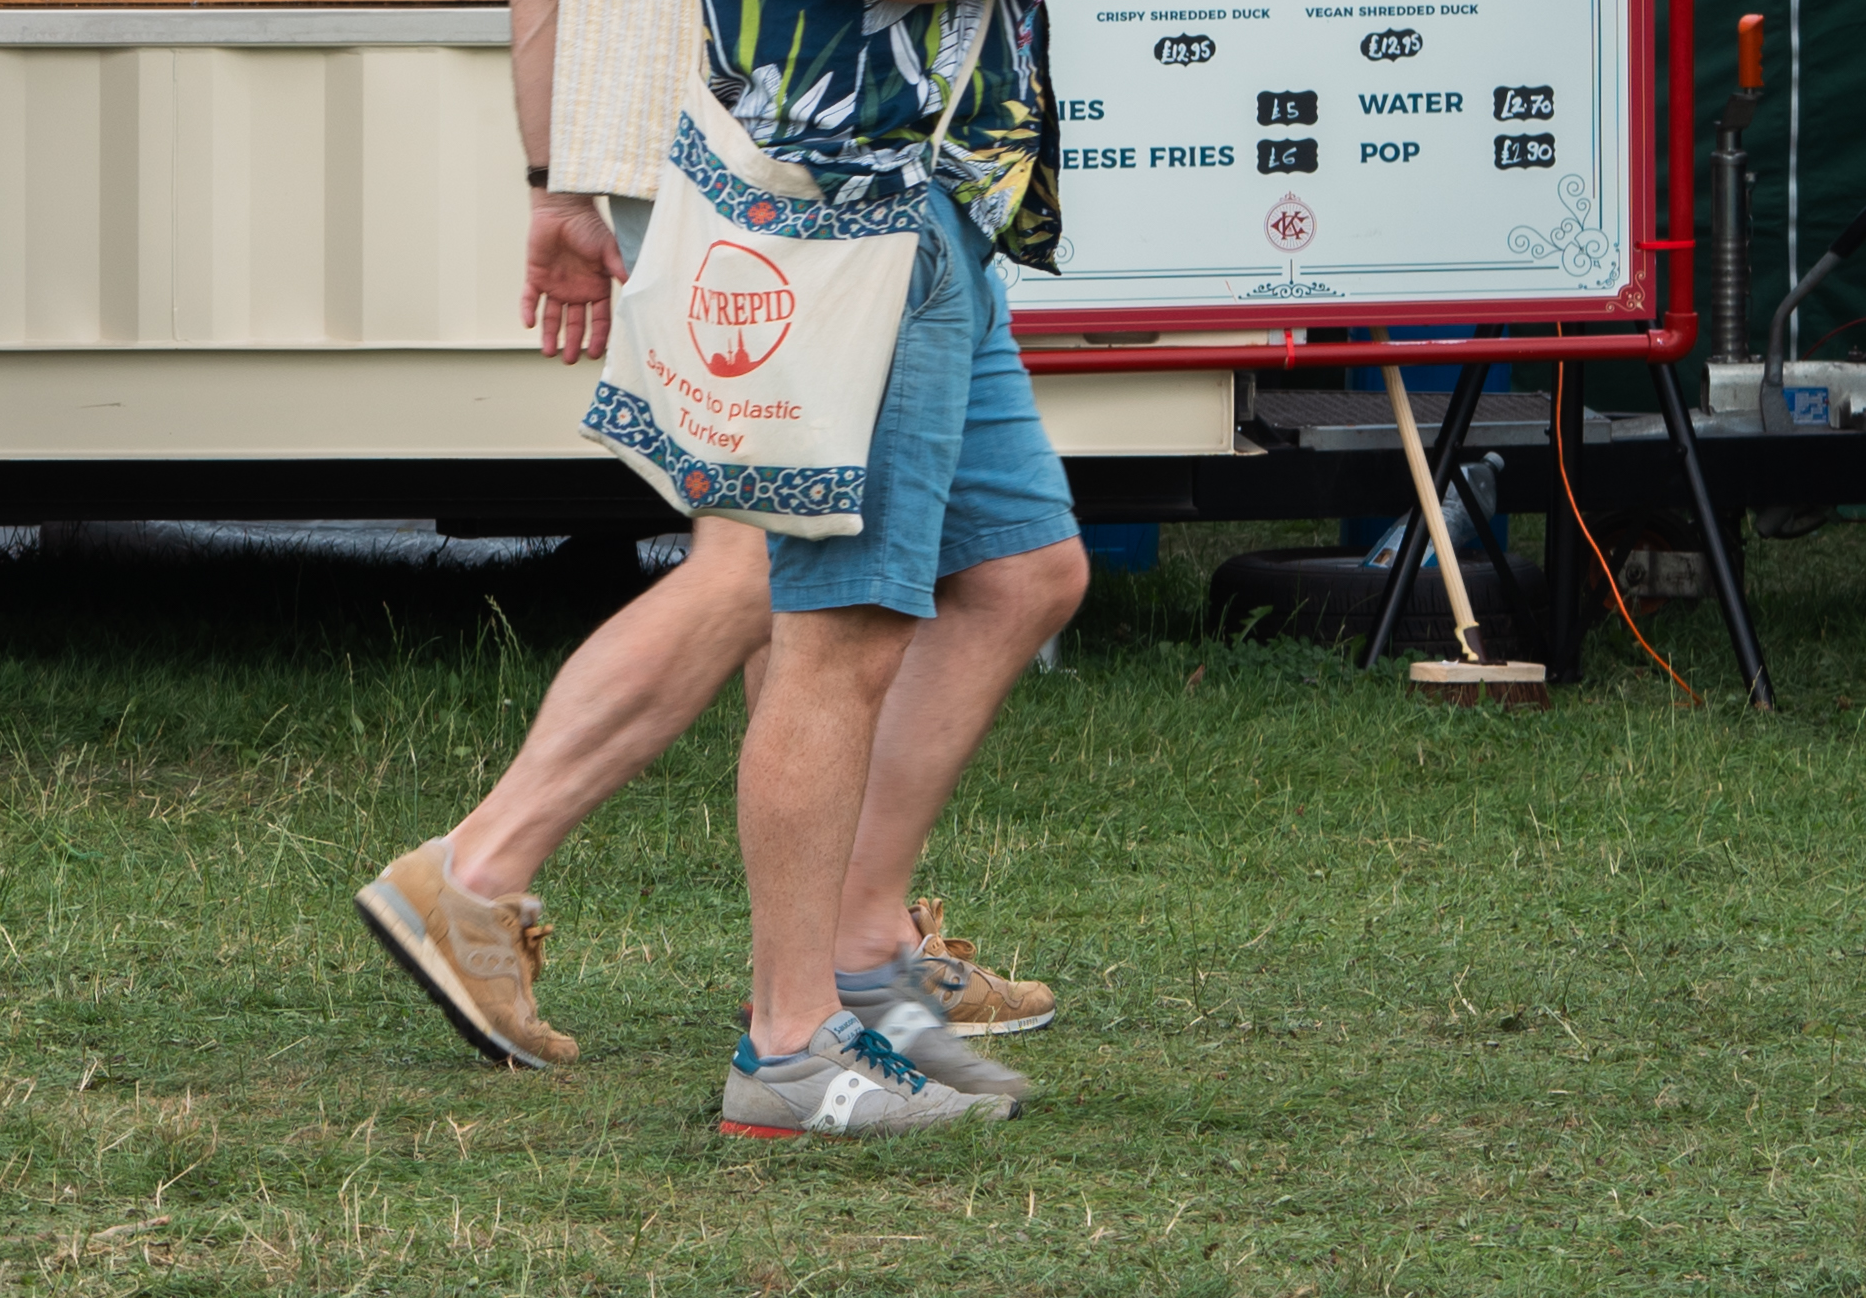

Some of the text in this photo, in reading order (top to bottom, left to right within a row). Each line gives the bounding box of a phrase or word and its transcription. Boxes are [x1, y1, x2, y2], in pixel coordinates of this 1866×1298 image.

[1059, 98, 1299, 121] IES £5
[1359, 92, 1463, 114] WATER
[1062, 146, 1296, 170] EESE FRIES £6
[1361, 142, 1420, 163] POP
[646, 349, 802, 421] Say no to plastic
[678, 407, 745, 453] Turkey
